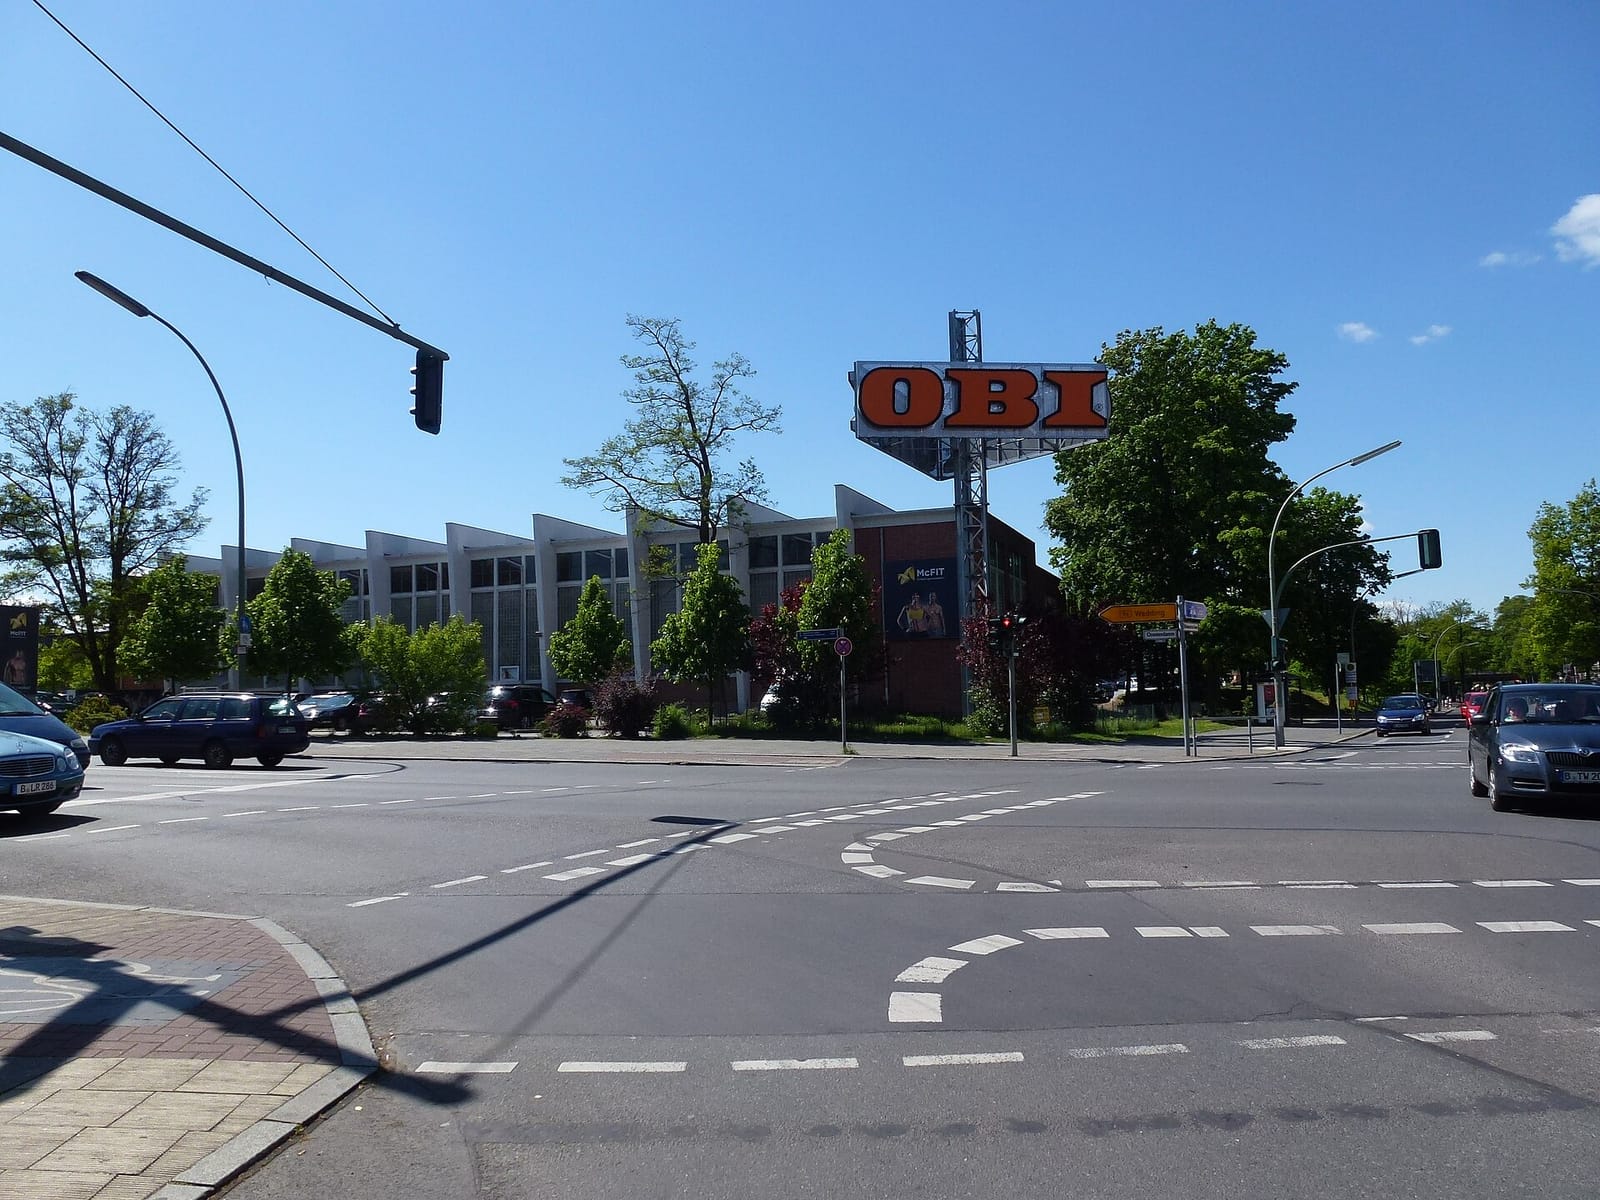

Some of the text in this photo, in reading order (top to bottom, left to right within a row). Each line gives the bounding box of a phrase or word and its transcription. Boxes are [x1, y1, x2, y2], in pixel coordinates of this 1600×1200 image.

[859, 366, 1107, 428] OBI
[916, 567, 945, 577] McFIT
[1564, 772, 1571, 780] B
[20, 784, 26, 793] B
[30, 783, 41, 793] LR
